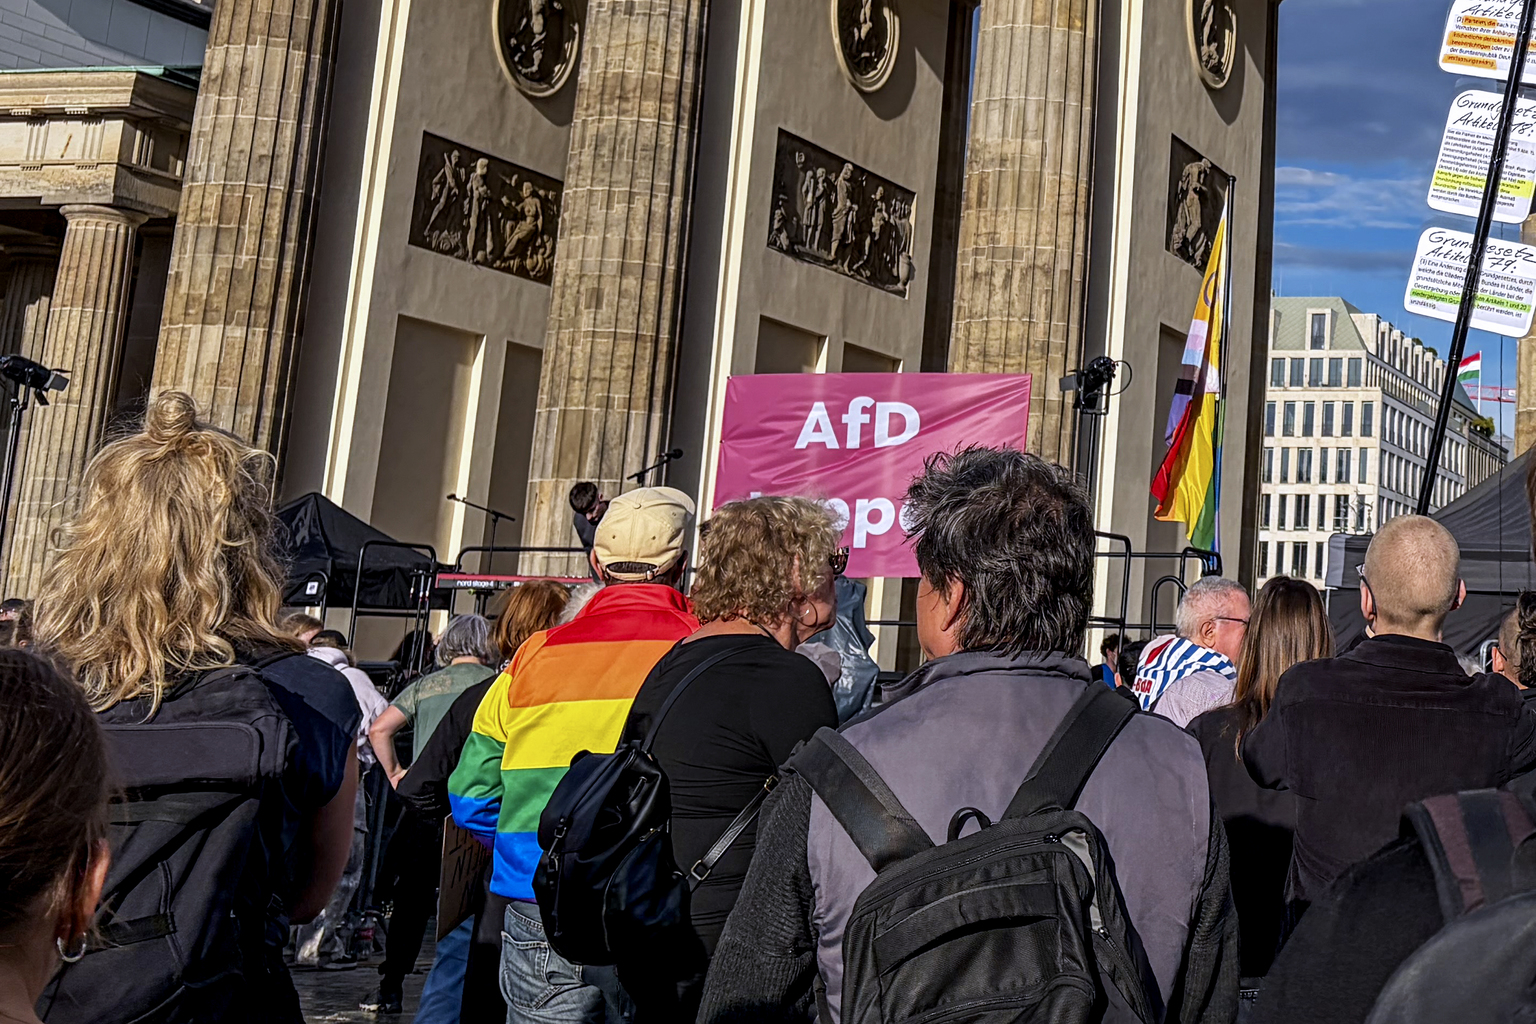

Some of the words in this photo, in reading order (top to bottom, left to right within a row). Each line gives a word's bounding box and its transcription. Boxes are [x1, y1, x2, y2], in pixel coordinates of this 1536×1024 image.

[1425, 246, 1471, 263] Artikel
[1487, 257, 1517, 273] 79:
[793, 396, 921, 449] AfD
